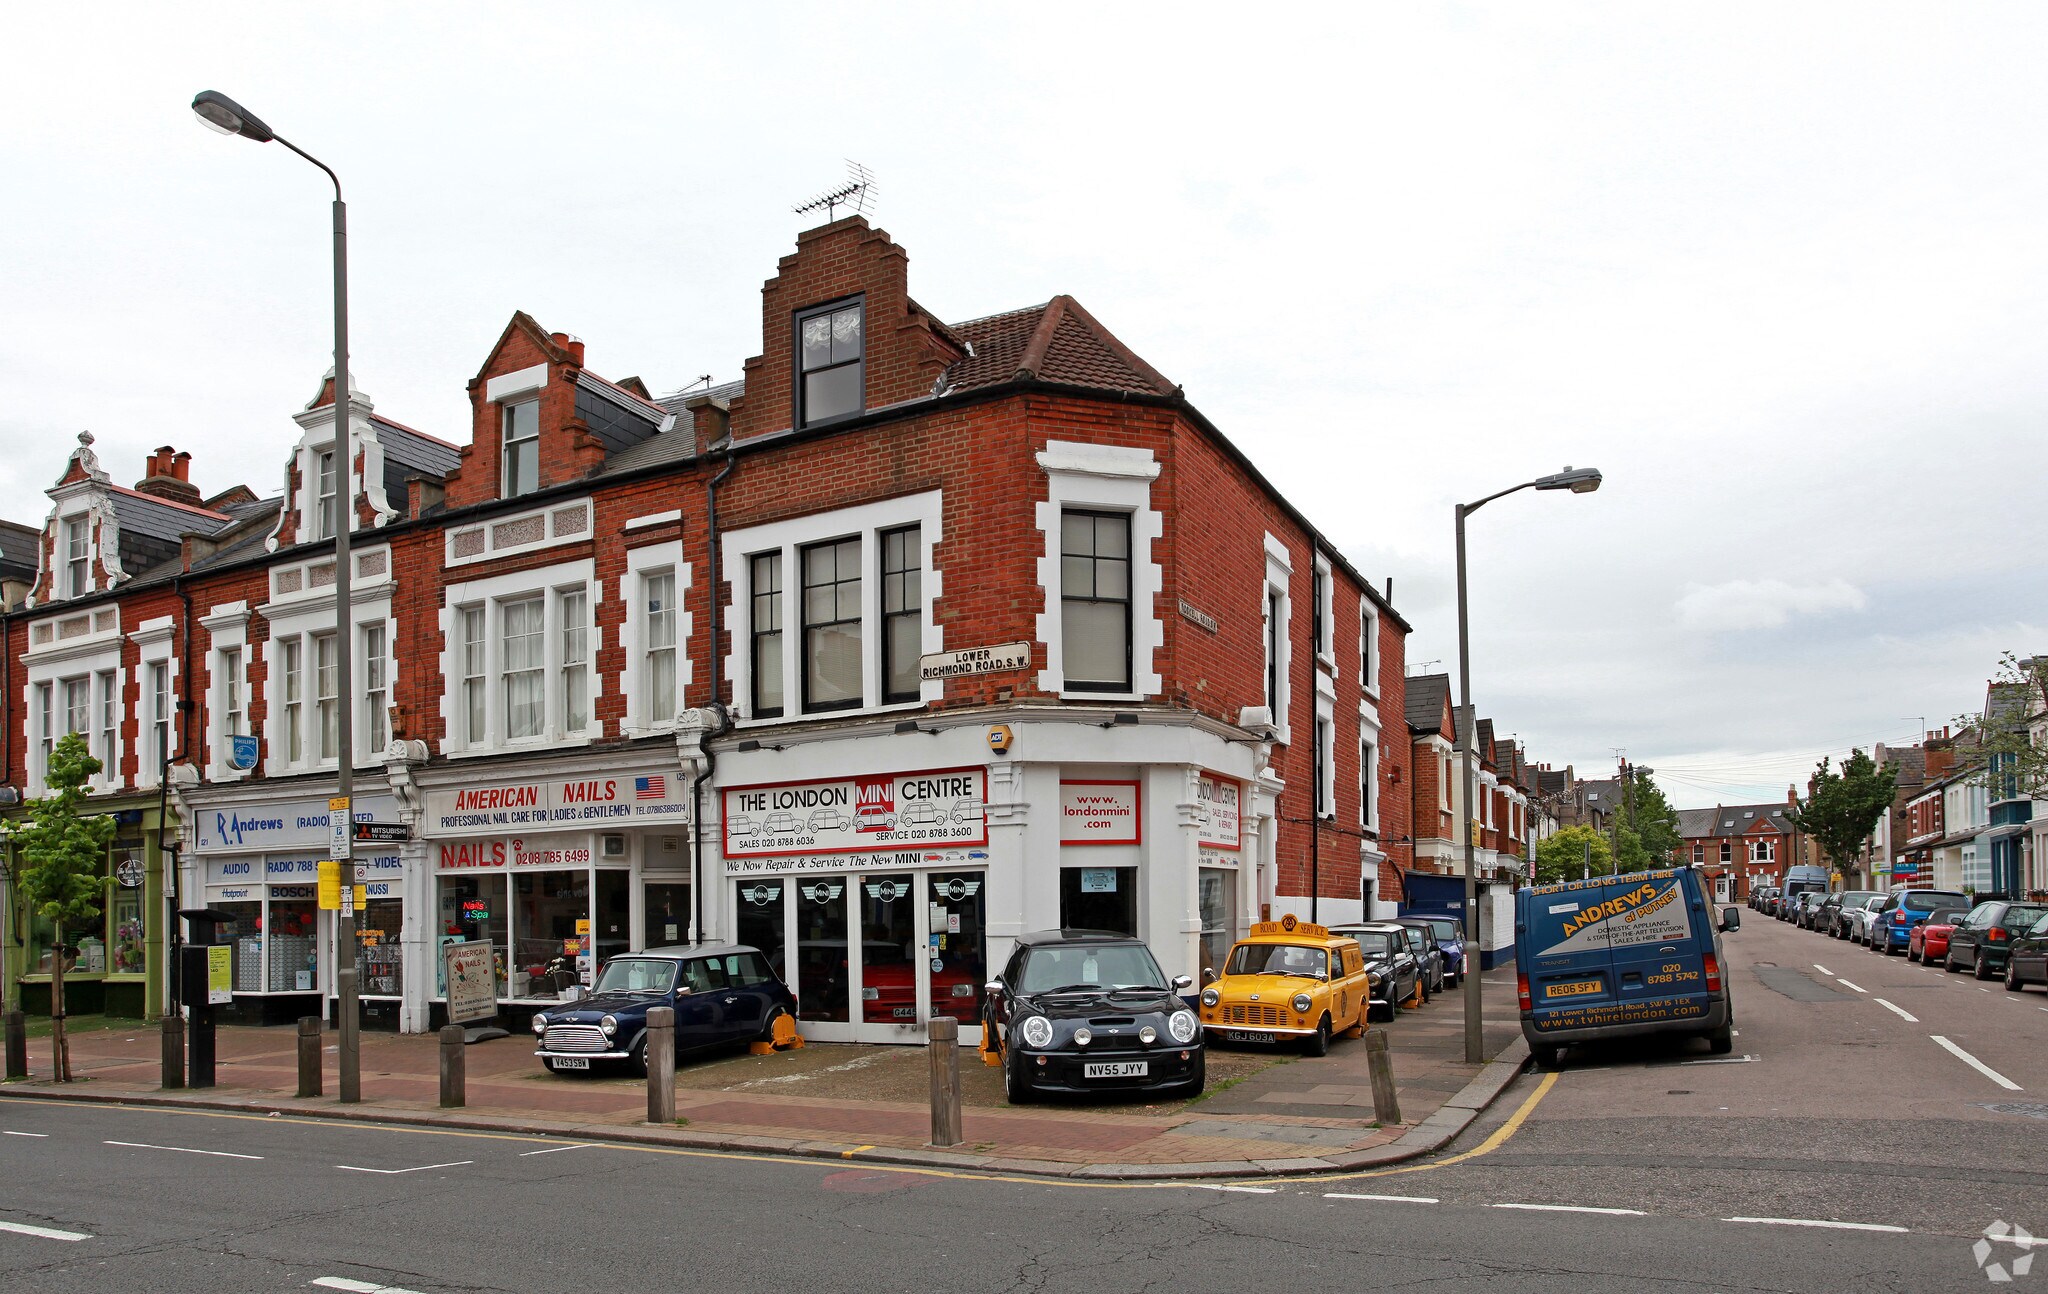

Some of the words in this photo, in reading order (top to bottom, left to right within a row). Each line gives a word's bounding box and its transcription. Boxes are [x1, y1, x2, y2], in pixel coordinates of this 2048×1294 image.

[955, 650, 990, 663] LOWER
[922, 663, 972, 678] RICHMOND
[991, 734, 1002, 742] ADT
[455, 786, 538, 811] AMERICAN
[563, 780, 616, 803] NAILS
[739, 793, 766, 812] THE
[772, 787, 848, 810] LONDON
[856, 783, 893, 804] MINI
[901, 777, 972, 801] CENTRE
[1076, 796, 1118, 804] www.
[441, 814, 492, 828] PROFESSIONAL
[493, 812, 510, 825] NAIL
[511, 811, 530, 823] CARE
[532, 809, 547, 822] FOR
[549, 807, 576, 821] LADIES
[583, 804, 631, 819] GENTLEMEN
[1064, 805, 1130, 816] londonmini
[297, 814, 330, 829] (RADIO)
[1083, 820, 1112, 828] .com
[371, 827, 407, 835] MITSUBISHI
[875, 830, 908, 841] SERVICE
[911, 830, 926, 839] 020
[929, 828, 948, 838] 8788
[950, 826, 972, 837] 3600
[739, 839, 760, 849] SALES
[761, 838, 775, 848] 020
[777, 837, 794, 847] 8788
[796, 836, 815, 846] 6036
[441, 841, 506, 869] NAILS
[516, 852, 541, 866] 0208
[543, 850, 562, 864] 785
[564, 849, 590, 864] 6499
[223, 862, 250, 875] AUDIO
[268, 861, 294, 873] RADIO
[297, 860, 313, 872] 788
[727, 861, 740, 872] We
[742, 860, 763, 871] Now
[765, 858, 795, 872] Repair
[797, 857, 806, 869] &
[809, 856, 845, 869] Service
[849, 855, 867, 867] The
[870, 853, 892, 866] New
[895, 852, 921, 865] MINI
[949, 885, 965, 894] MINI
[1532, 884, 1565, 896] SHORT
[1568, 882, 1583, 890] OR
[1586, 878, 1616, 888] LONG
[1619, 874, 1648, 883] TERM
[1651, 870, 1675, 879] HIRE
[222, 888, 248, 900] Hotpoint
[271, 887, 315, 898] BOSCH
[754, 891, 768, 899] MINI
[815, 889, 830, 897] MINI
[880, 887, 895, 895] MINI
[462, 901, 485, 910] Nails
[1562, 883, 1657, 938] ANDREWS
[1625, 911, 1636, 923] of
[1637, 888, 1678, 917] PUTNEY
[470, 910, 489, 920] Spa
[1259, 923, 1277, 933] ROAD
[1300, 925, 1325, 936] SERVICE
[1598, 924, 1631, 934] DOMESTIC
[1632, 920, 1670, 929] APPLIANCE
[1649, 925, 1684, 934] TELEVISION
[458, 949, 487, 958] AMERICAN
[465, 960, 481, 968] NAILS
[1662, 963, 1681, 973] 020
[1647, 974, 1673, 984] 8788
[1676, 971, 1699, 981] 5742
[1550, 985, 1576, 995] RE06
[1577, 982, 1597, 992] SFY
[894, 1008, 917, 1017] G445
[1562, 1008, 1584, 1017] Lower
[1586, 1003, 1623, 1014] Richmond
[1540, 1006, 1700, 1029] www.tvhirelondon.com
[1228, 1031, 1247, 1040] KGJ
[1249, 1033, 1274, 1042] 603A
[1089, 1065, 1119, 1076] NV55
[1122, 1063, 1143, 1075] JYY
